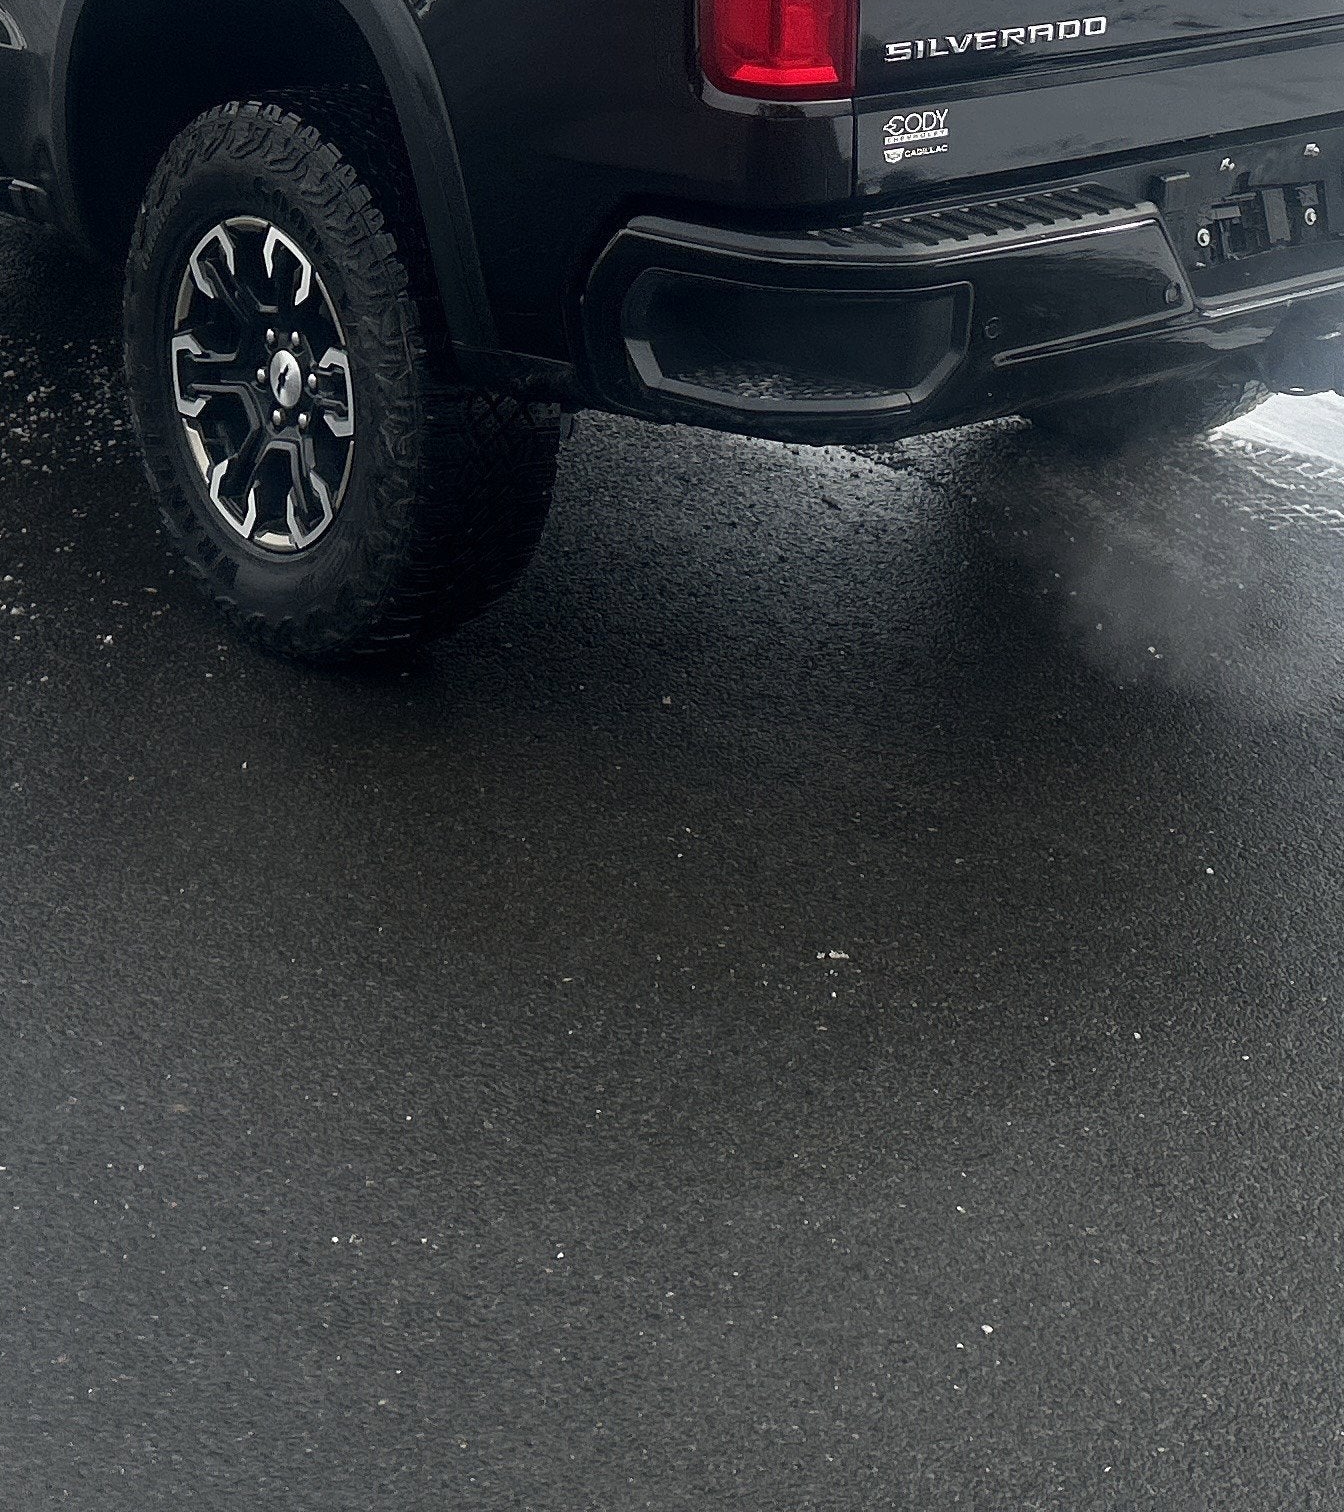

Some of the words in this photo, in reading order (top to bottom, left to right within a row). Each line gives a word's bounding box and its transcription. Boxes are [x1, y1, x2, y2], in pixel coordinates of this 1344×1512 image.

[884, 15, 1107, 63] SILVERADO
[883, 108, 949, 136] CODY
[904, 144, 948, 158] CADILLAC
